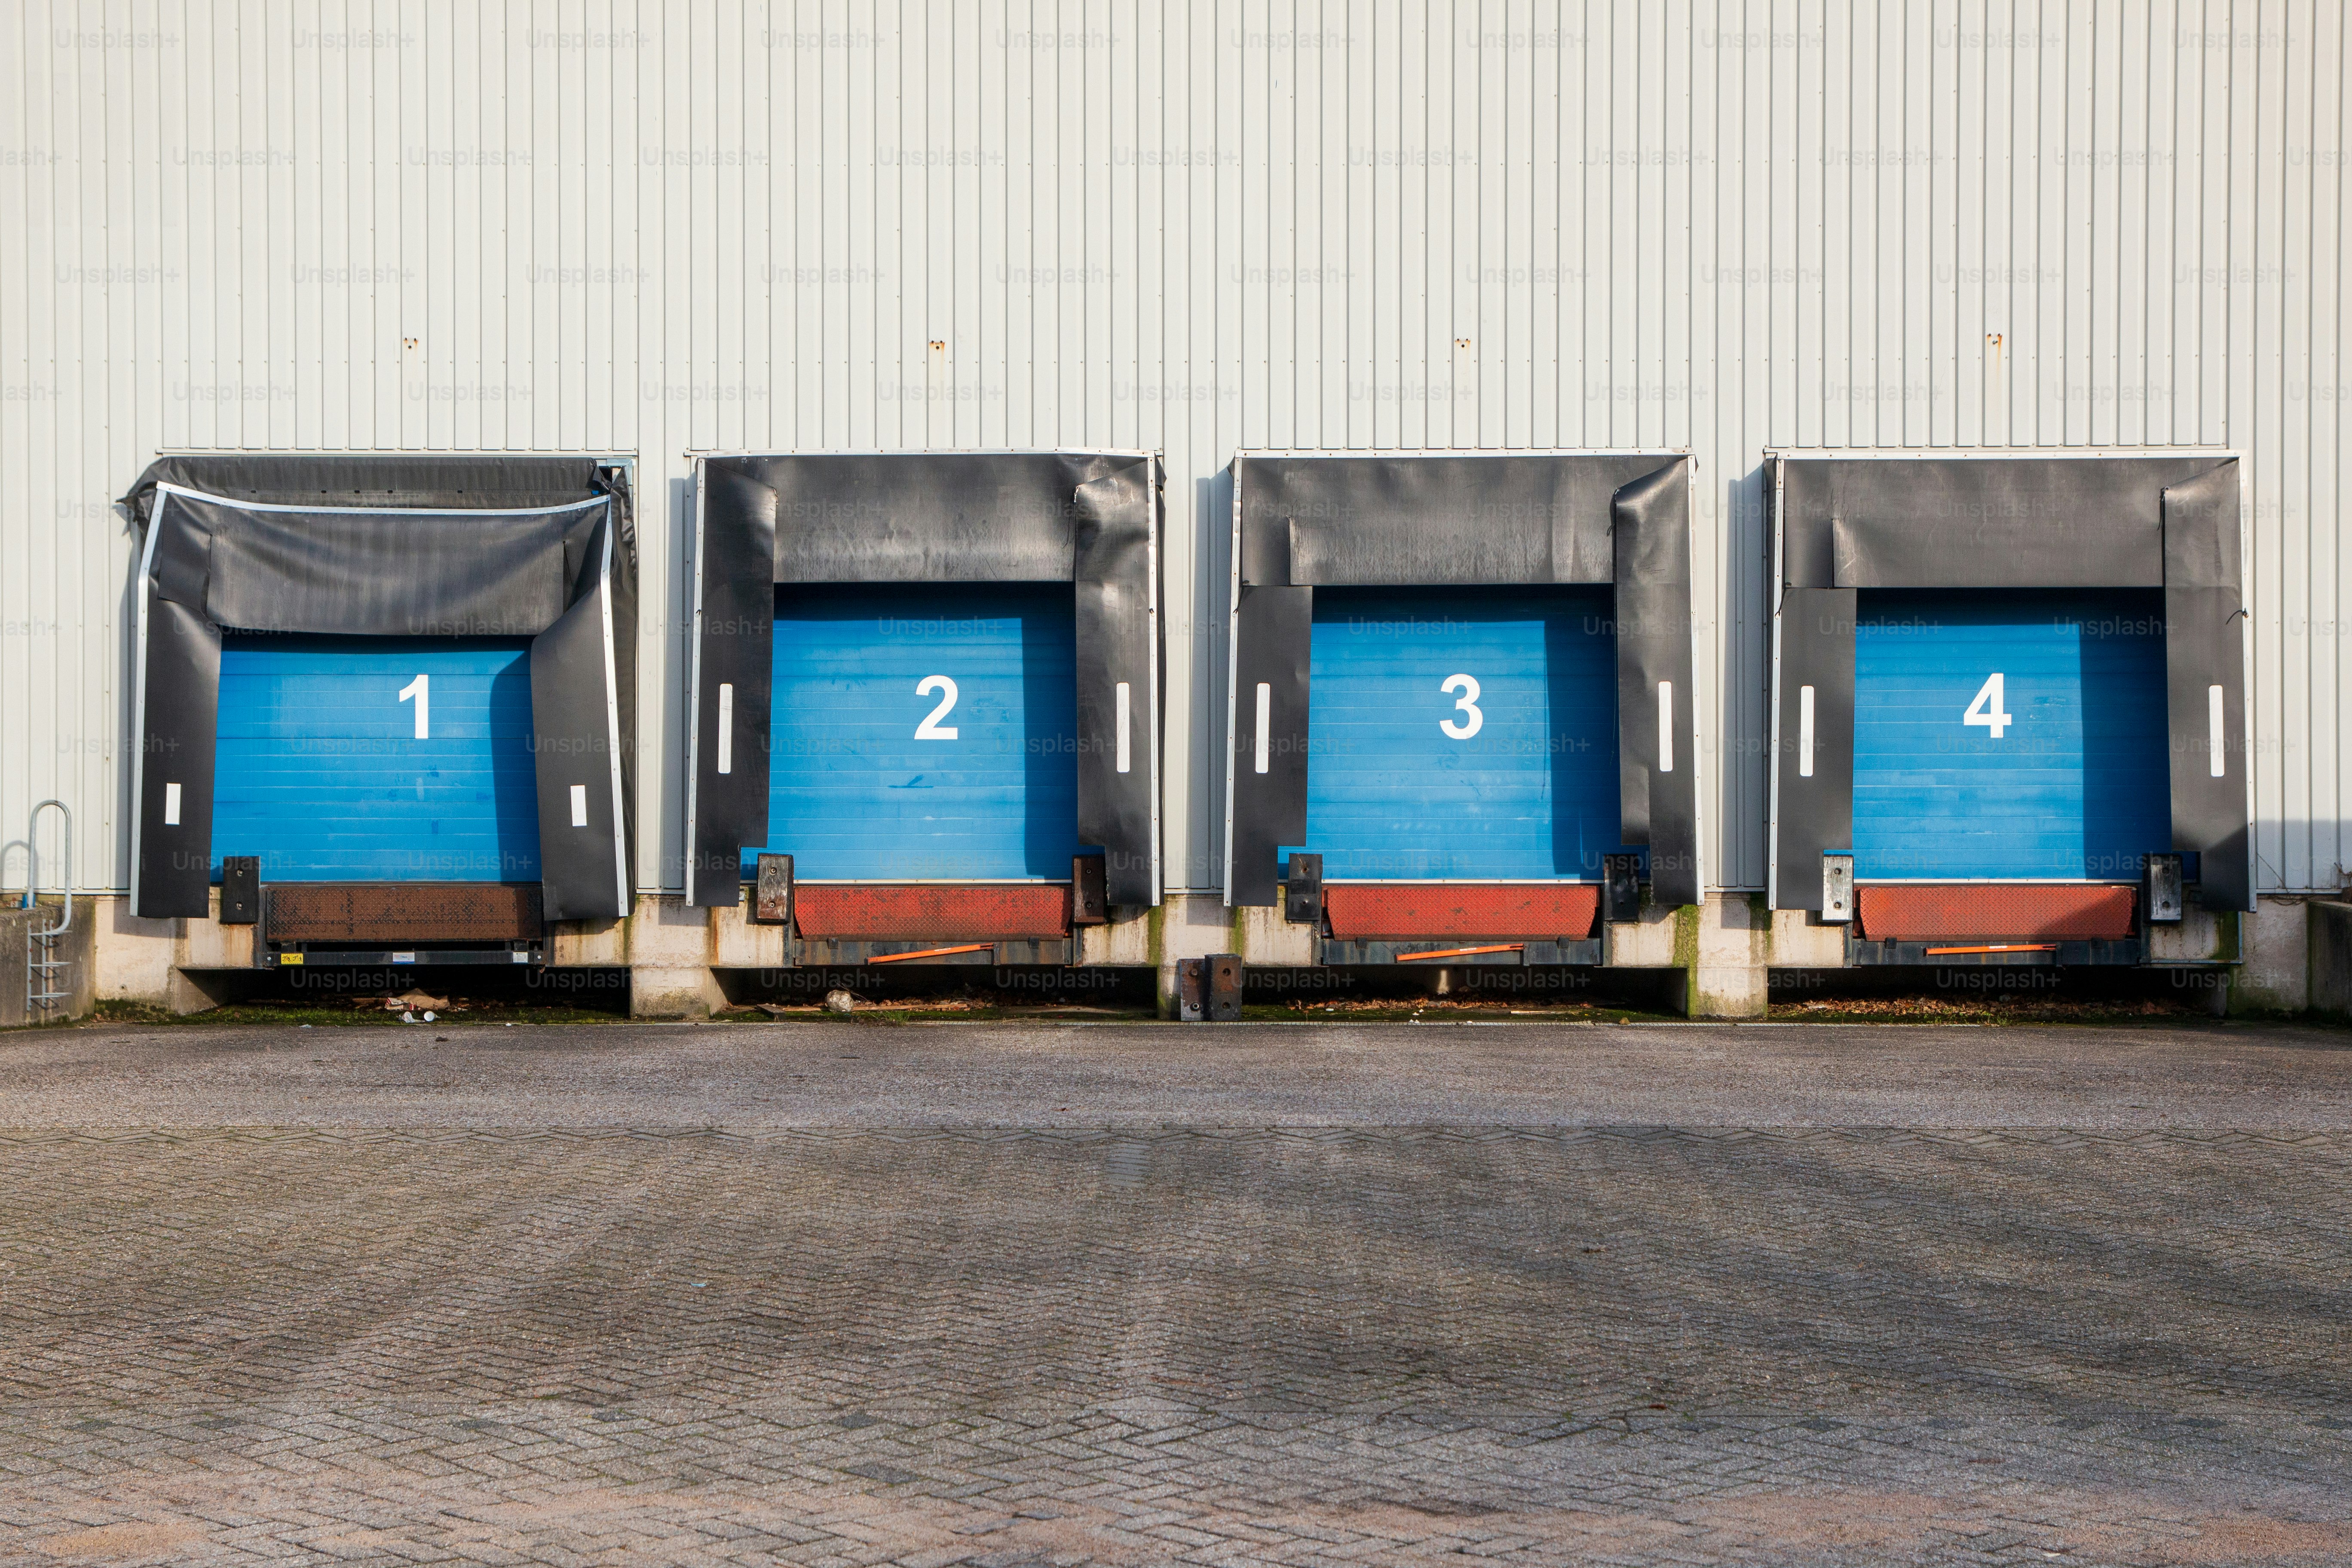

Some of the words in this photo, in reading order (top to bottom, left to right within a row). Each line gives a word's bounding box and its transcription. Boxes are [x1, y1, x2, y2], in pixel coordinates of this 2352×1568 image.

[399, 675, 428, 738] 1
[914, 675, 958, 739] 2
[1439, 674, 1483, 739] 3
[1964, 673, 2012, 738] 4
